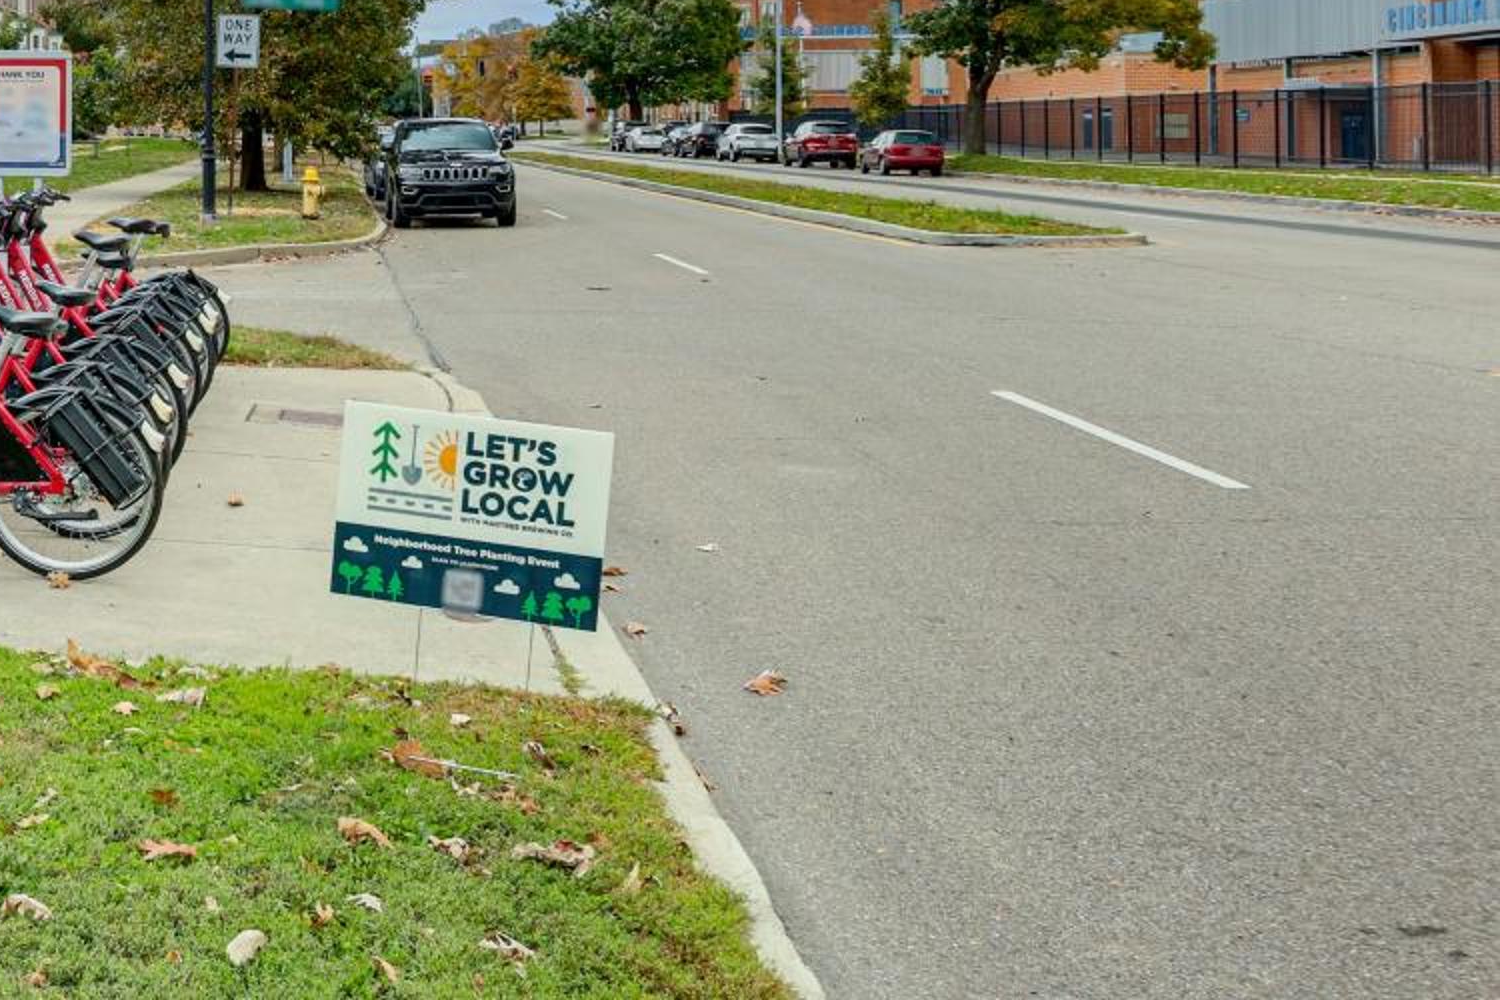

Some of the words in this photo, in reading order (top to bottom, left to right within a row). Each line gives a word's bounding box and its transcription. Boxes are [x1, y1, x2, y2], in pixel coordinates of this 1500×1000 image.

[223, 33, 253, 45] WAY
[224, 19, 252, 31] ONE
[465, 431, 557, 466] LET'S
[463, 461, 575, 497] GROW
[462, 489, 575, 527] LOCAL
[374, 534, 451, 554] Neighborhood
[453, 545, 479, 558] Tree
[479, 548, 526, 566] Planting
[527, 556, 561, 570] Event
